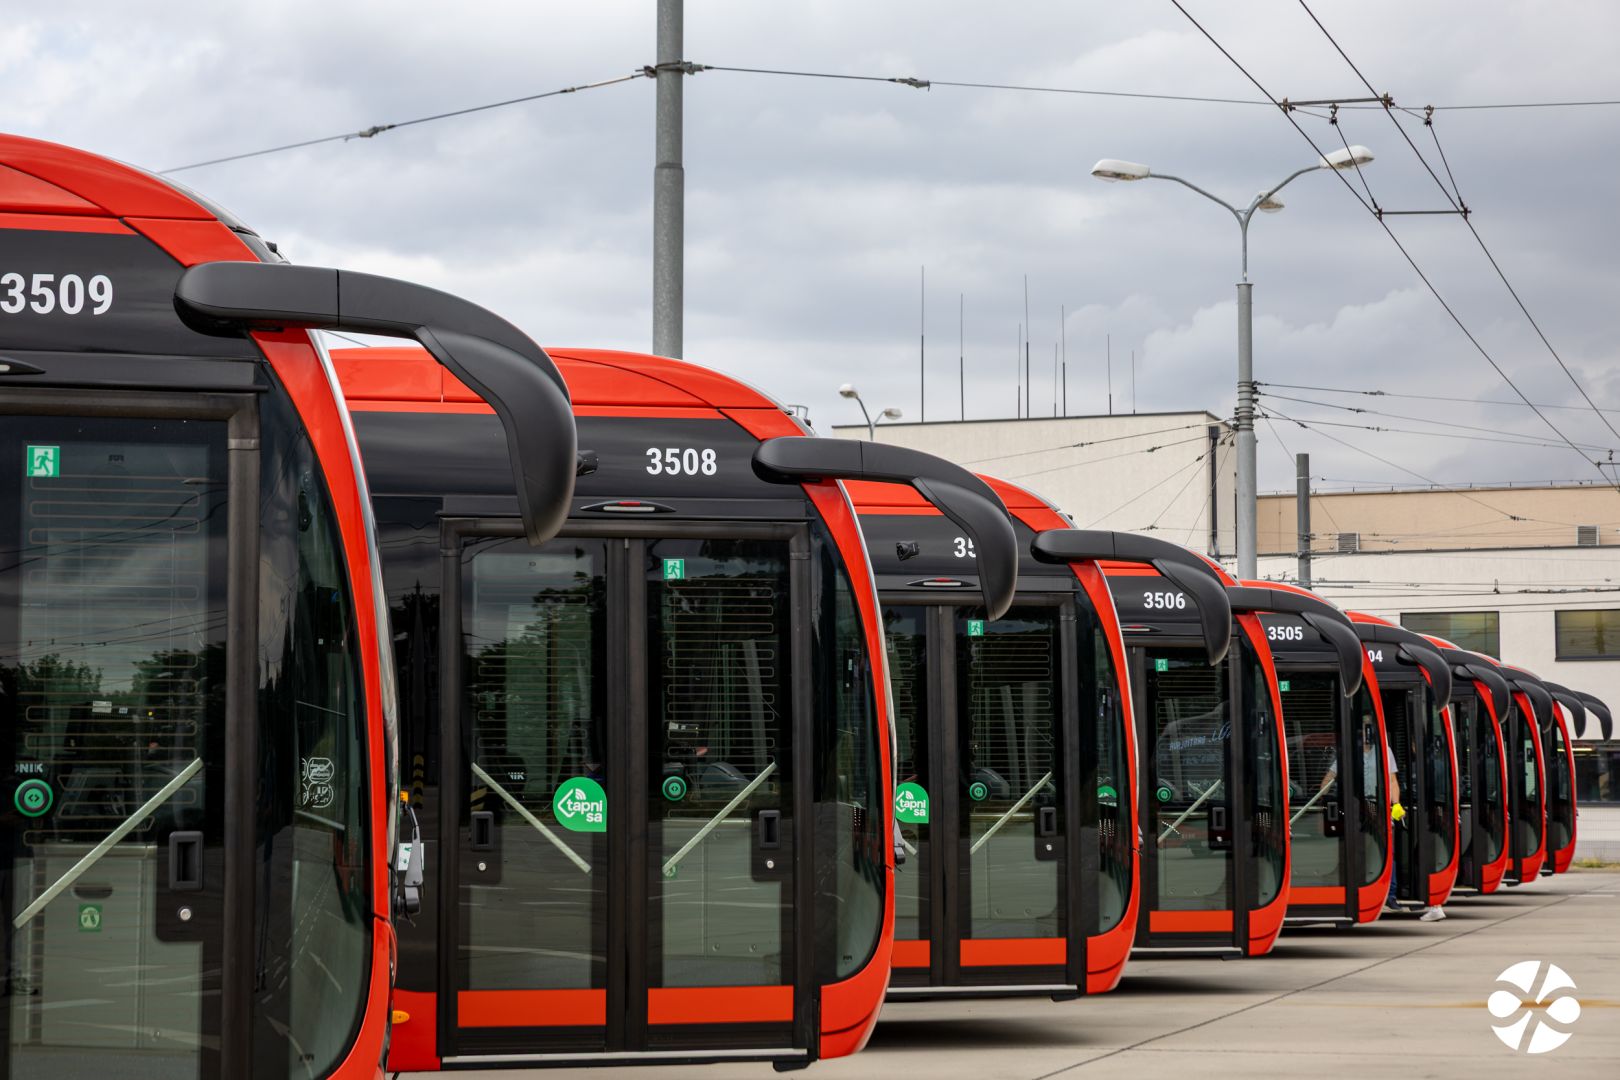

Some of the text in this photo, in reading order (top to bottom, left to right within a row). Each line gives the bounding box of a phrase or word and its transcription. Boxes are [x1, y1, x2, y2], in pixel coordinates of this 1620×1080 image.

[0, 272, 113, 315] 3509
[646, 447, 717, 475] 3508
[953, 537, 977, 558] 35
[1143, 591, 1186, 609] 3506
[1268, 626, 1303, 640] 3505
[1367, 649, 1384, 663] 04
[566, 799, 603, 815] tapni
[899, 798, 926, 811] tapni
[585, 812, 603, 823] sa
[913, 808, 926, 817] sa
